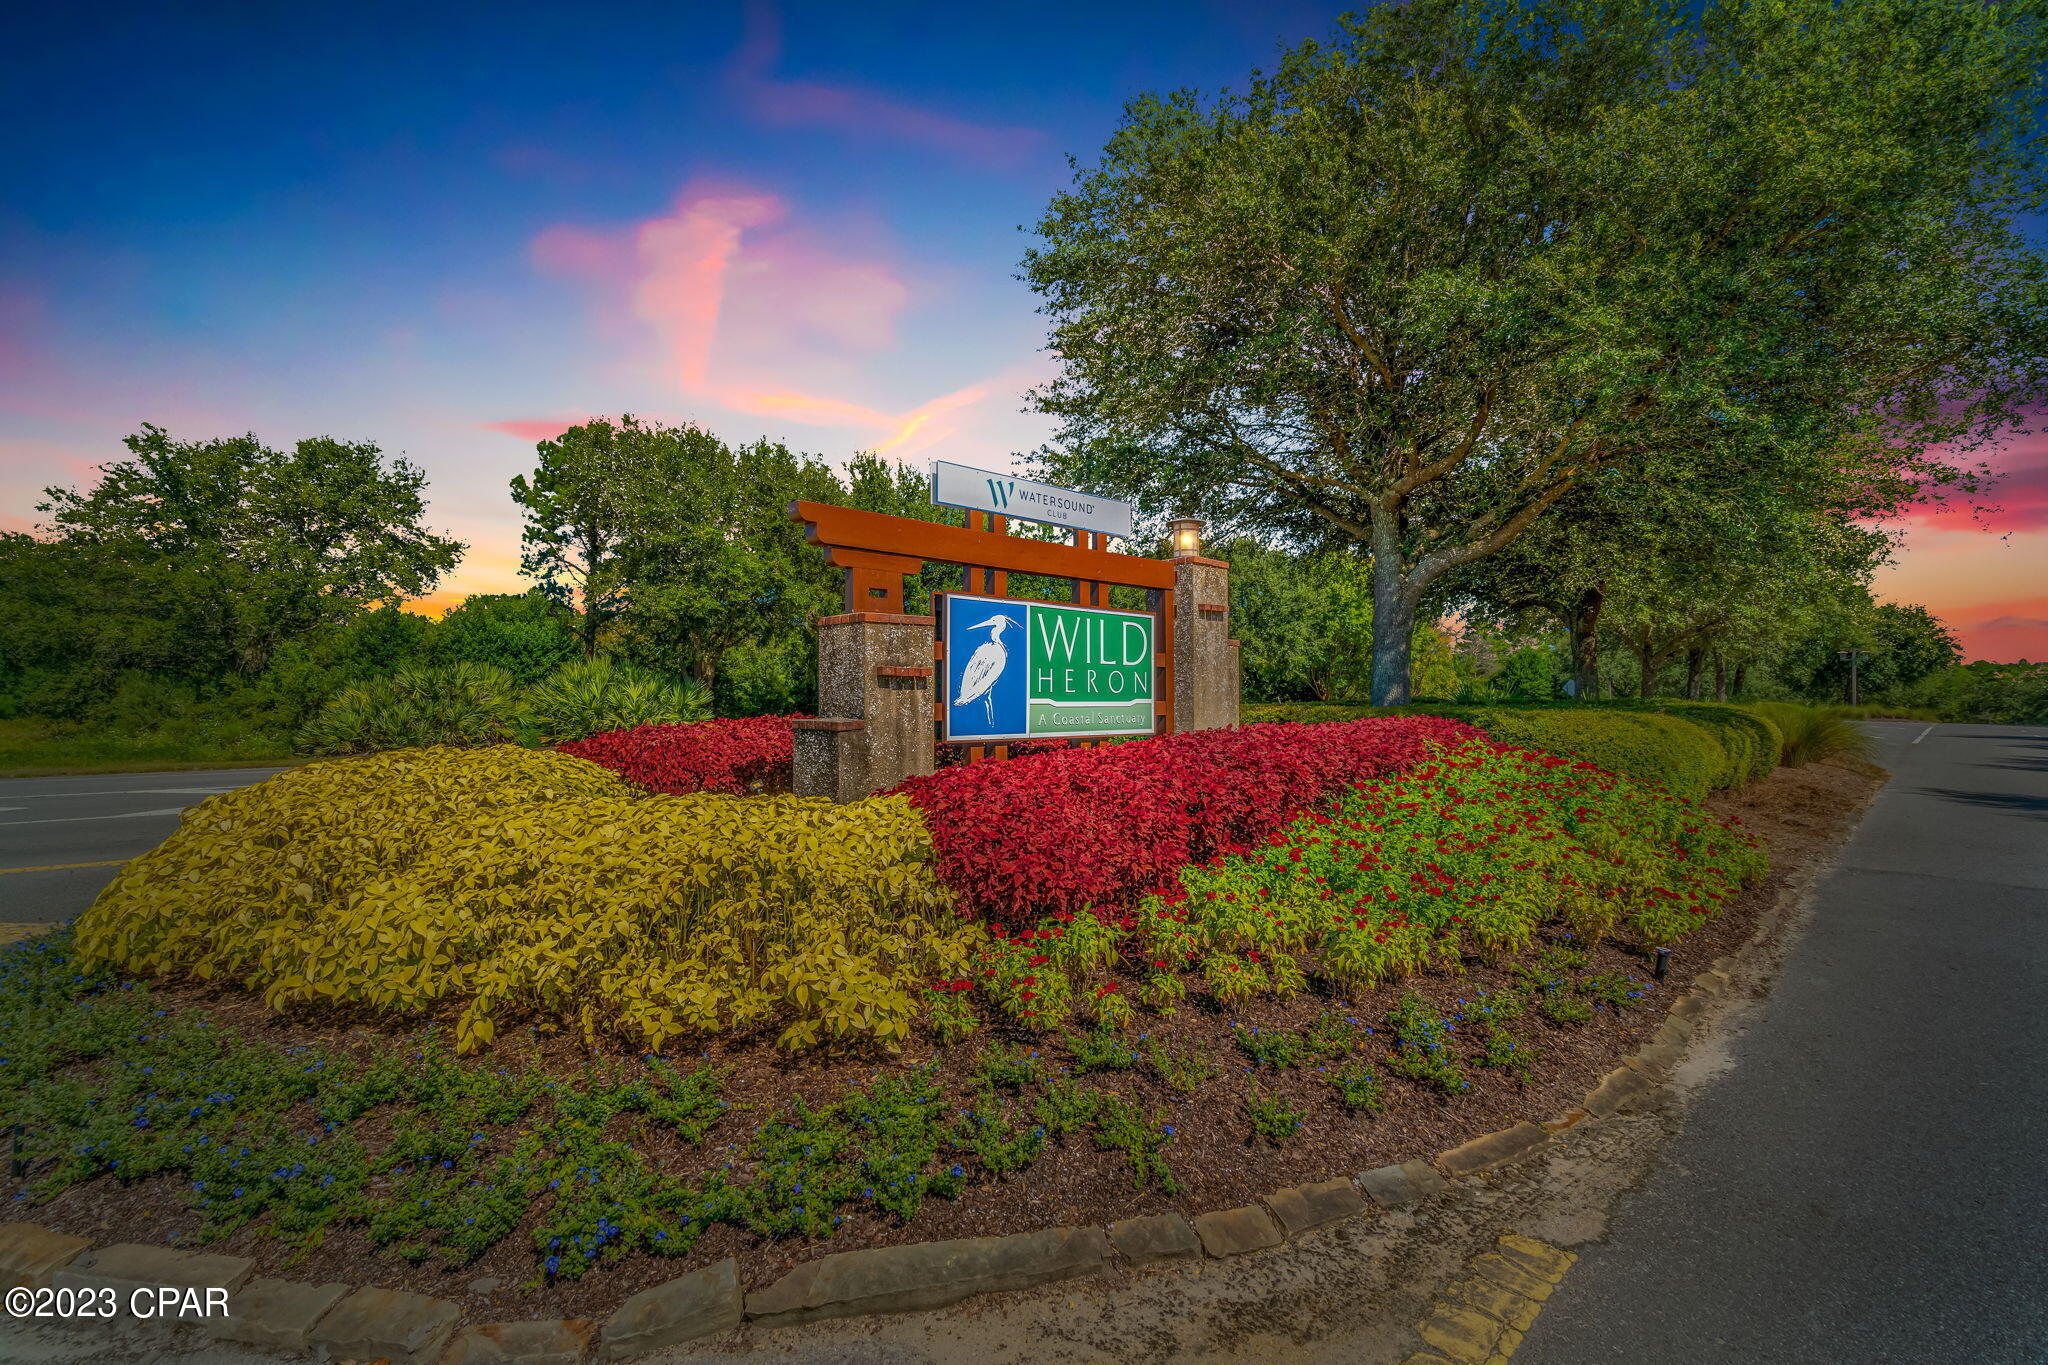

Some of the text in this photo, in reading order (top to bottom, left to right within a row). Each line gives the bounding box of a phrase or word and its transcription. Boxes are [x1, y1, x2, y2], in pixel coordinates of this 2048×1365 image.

[1019, 489, 1093, 515] WATERSOUND
[1047, 509, 1068, 520] CLUB
[1037, 613, 1148, 666] WILD
[1038, 668, 1148, 694] HERON
[1038, 712, 1146, 726] A Coastal Sanctuary
